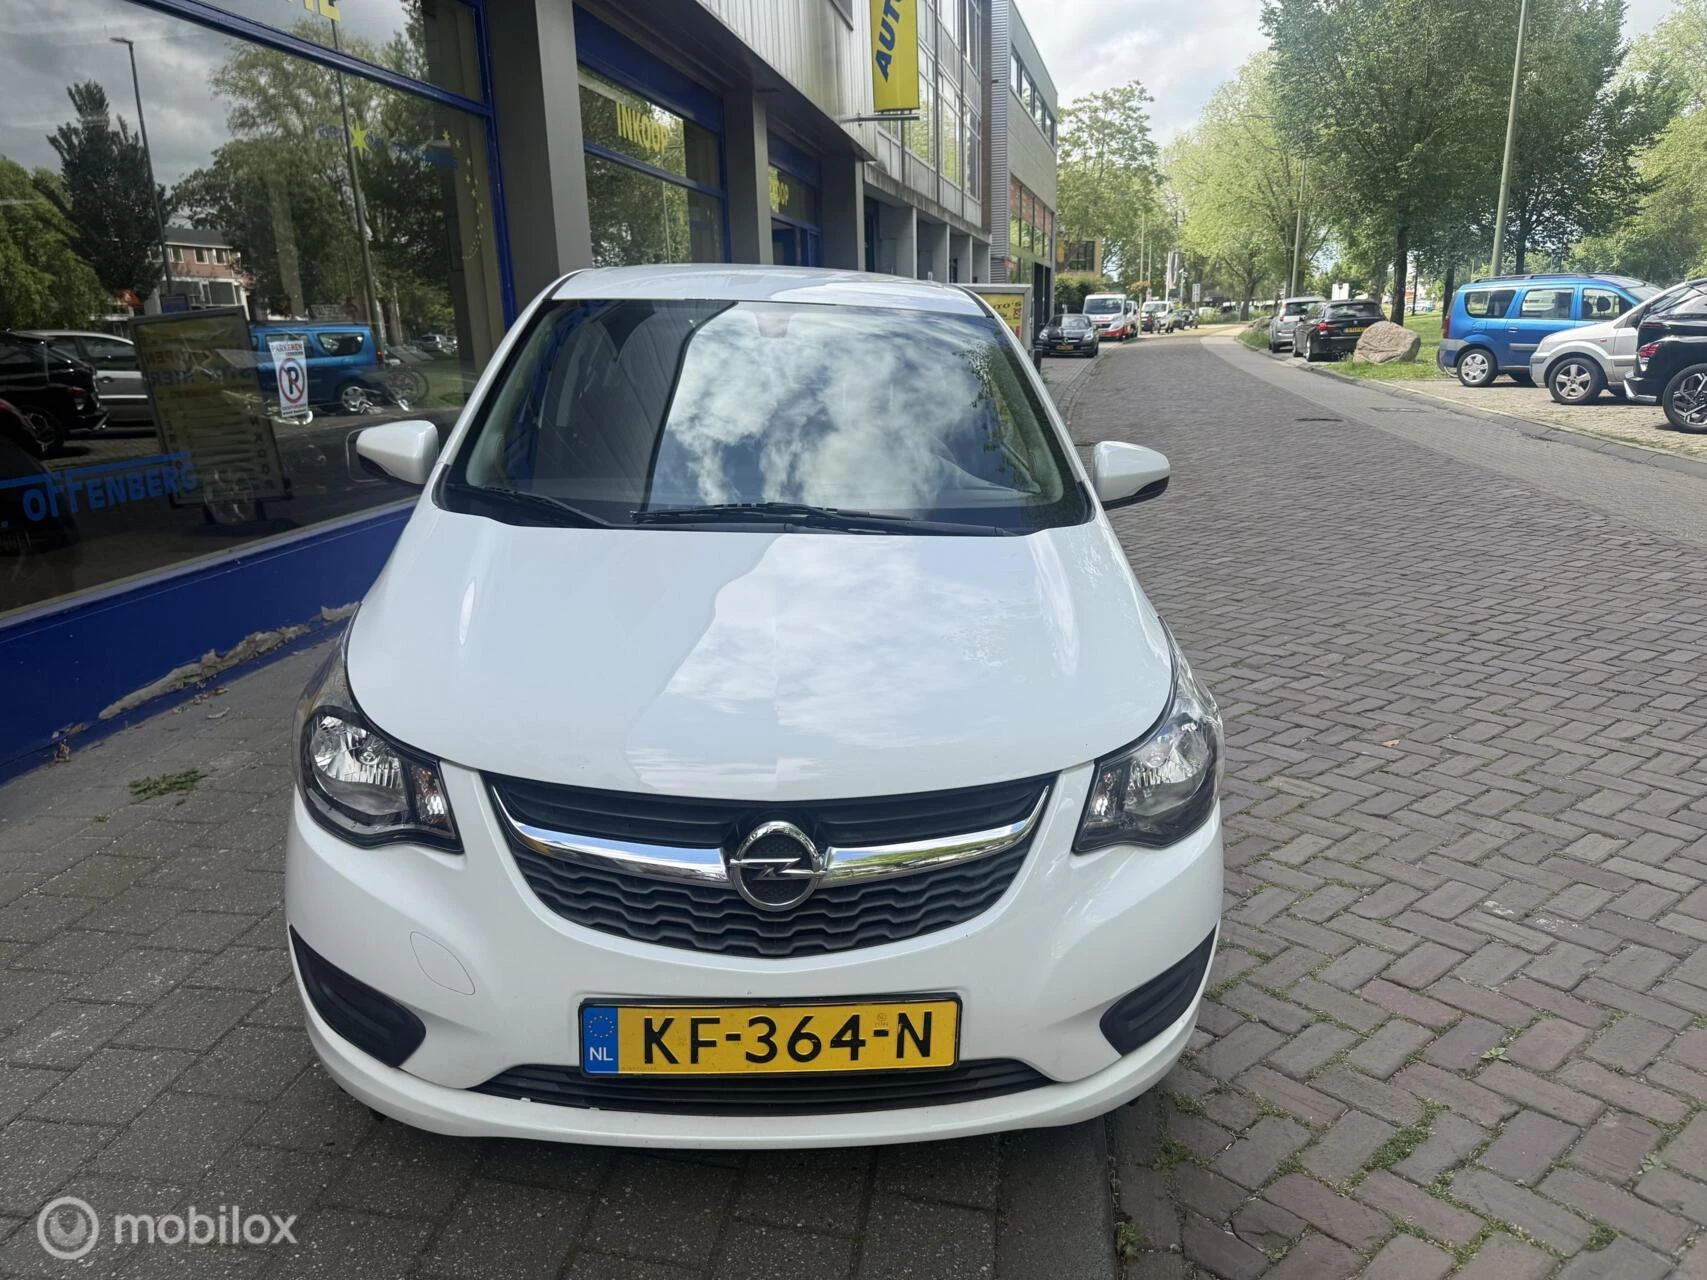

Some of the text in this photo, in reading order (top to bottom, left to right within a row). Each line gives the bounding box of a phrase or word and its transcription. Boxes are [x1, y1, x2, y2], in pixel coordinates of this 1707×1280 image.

[875, 0, 902, 83] AUT
[616, 101, 669, 154] INKOOP
[22, 462, 197, 521] OFFENBERG
[589, 1046, 614, 1061] NL
[643, 1011, 932, 1064] KF-364-N
